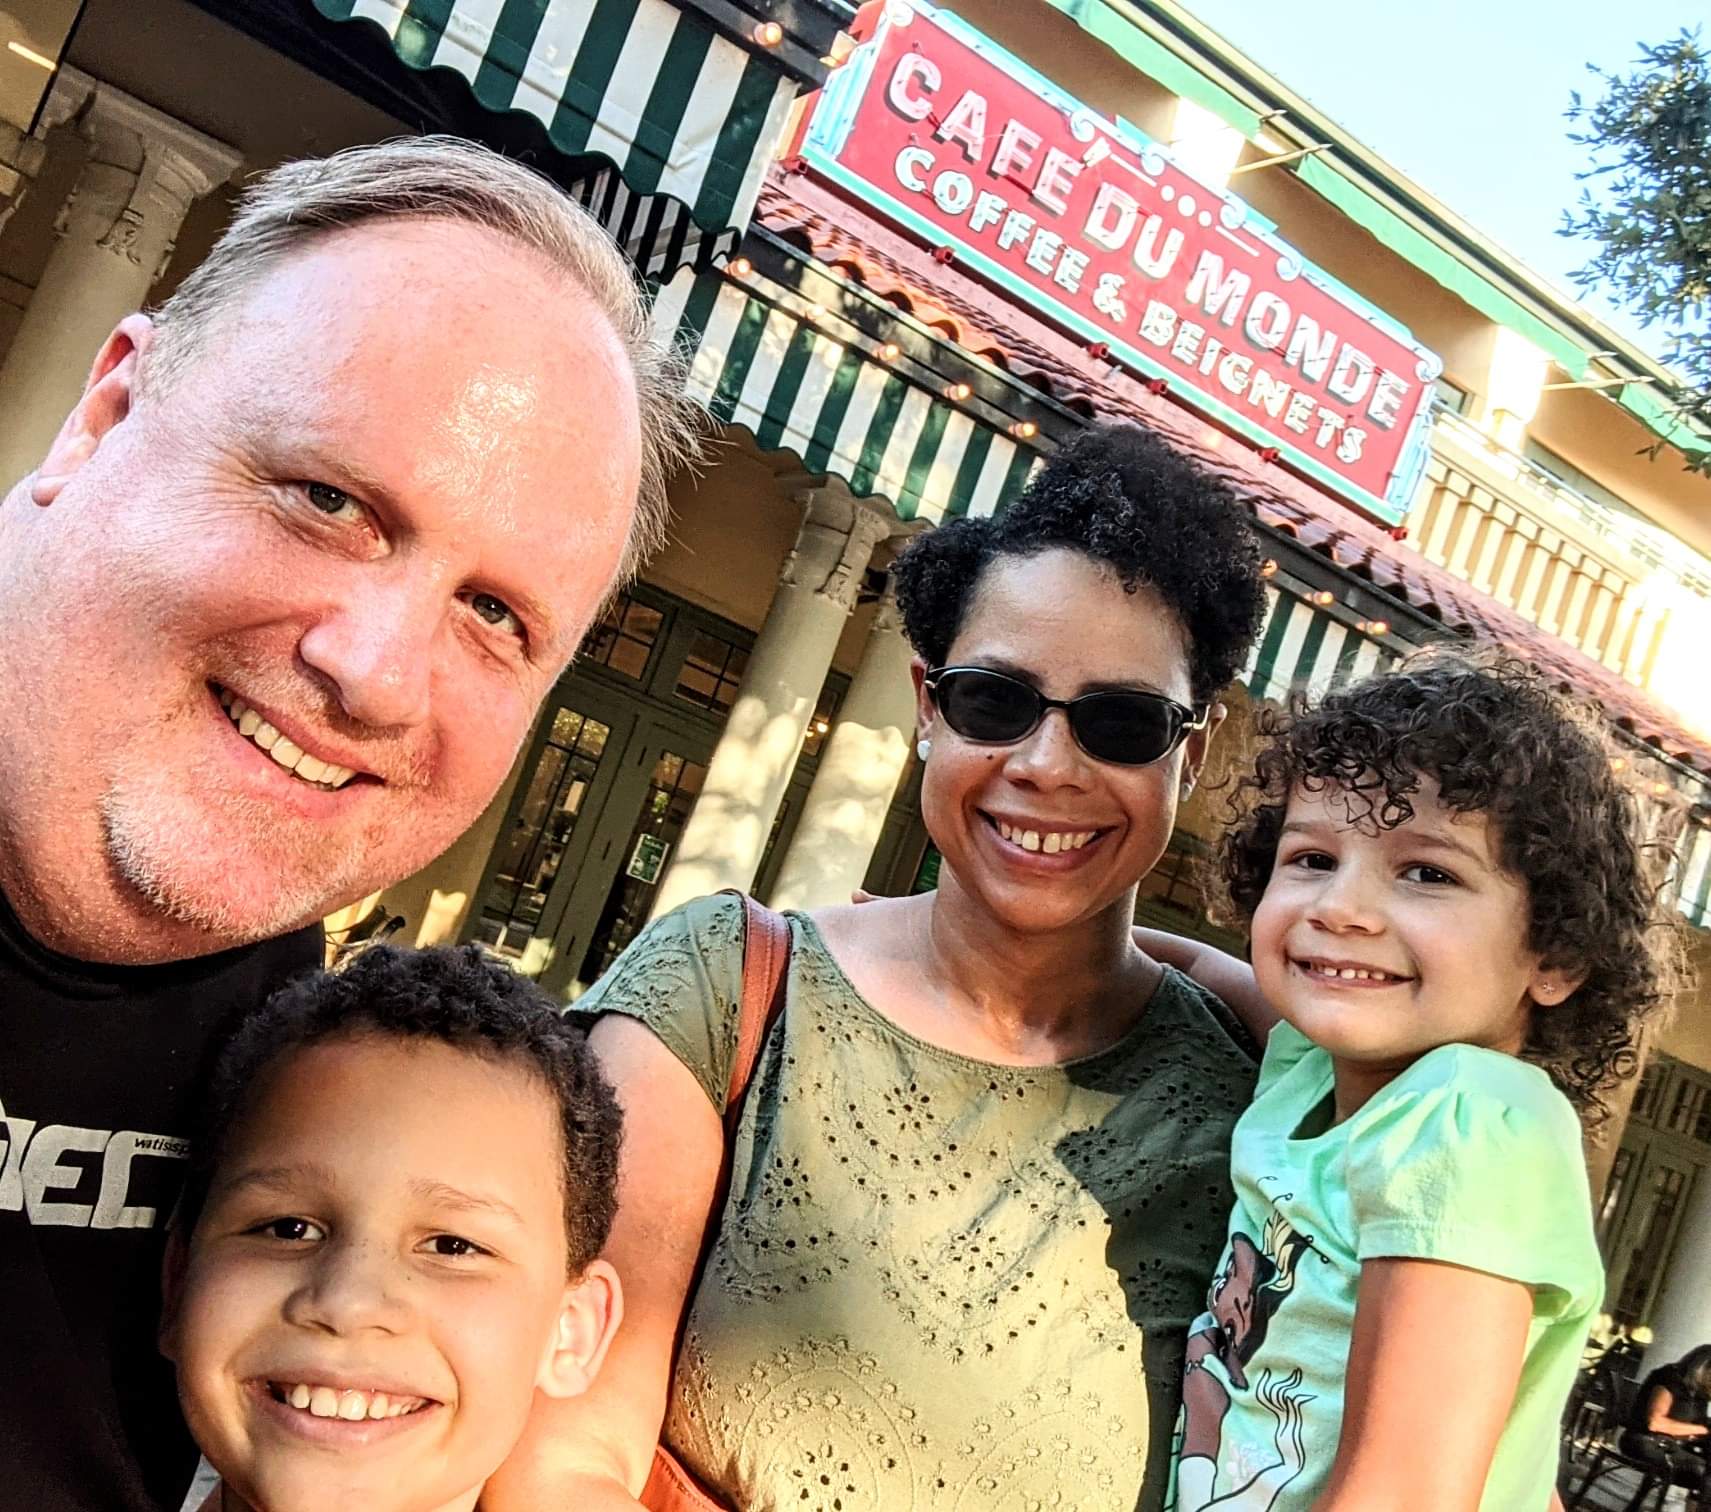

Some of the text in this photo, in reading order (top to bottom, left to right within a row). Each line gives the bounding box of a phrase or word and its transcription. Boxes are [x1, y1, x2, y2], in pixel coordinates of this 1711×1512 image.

[894, 146, 1367, 463] COFFEE & BEIGNETS
[1083, 181, 1185, 280] DU
[1185, 249, 1410, 429] MONDE
